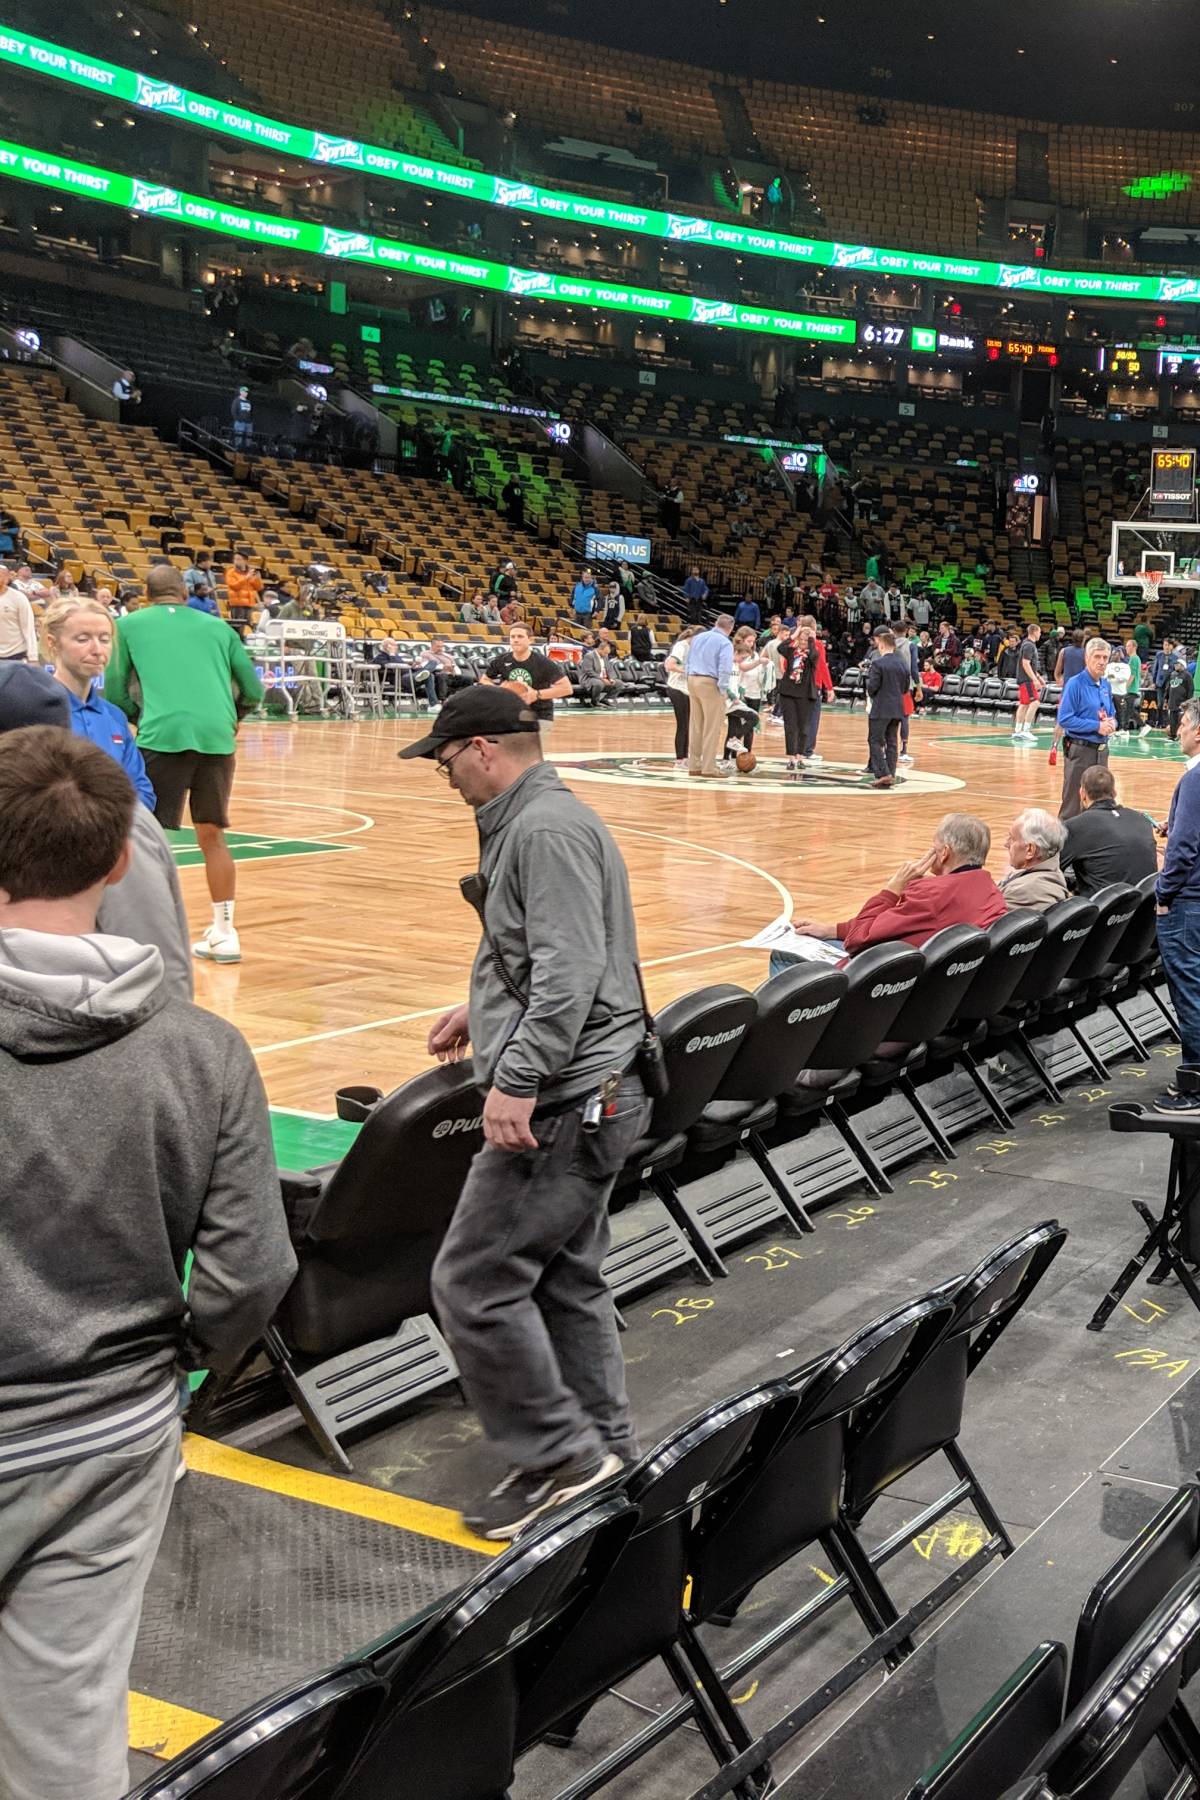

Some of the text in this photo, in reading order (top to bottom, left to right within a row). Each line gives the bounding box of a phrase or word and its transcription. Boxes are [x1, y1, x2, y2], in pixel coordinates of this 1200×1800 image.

[30, 44, 116, 86] YOUR THIRST
[139, 84, 182, 106] Sprite
[189, 101, 291, 145] OBEY YOUR THIRST
[316, 140, 361, 163] Sprite
[22, 156, 110, 192] YOUR THIRST
[366, 154, 476, 190] OBEY YOUR THIRST
[135, 188, 178, 211] Sprite
[497, 183, 534, 204] Sprite
[185, 202, 300, 241] OBEY YOUR THIRST
[540, 197, 648, 226] OBEY YOUR THIRST
[669, 217, 709, 239] Sprite
[326, 234, 372, 257] Sprite
[715, 230, 814, 257] OBEY YOUR THIRST
[378, 246, 489, 279] OBEY YOUR THIRST
[835, 247, 874, 267] Sprite
[881, 256, 980, 277] OBEY YOUR THIRST
[509, 272, 552, 295] Sprite
[1002, 269, 1037, 287] Sprite
[1044, 276, 1141, 292] OBEY YOUR THIRST
[559, 283, 672, 310] OBEY YOUR THIRST
[1163, 280, 1197, 300] Sprite
[694, 303, 733, 322] Sprite
[740, 313, 844, 336] OBEY YOUR THIRST
[863, 325, 904, 346] 6:27
[940, 335, 974, 349] Bank
[1008, 342, 1033, 354] 65:40
[792, 452, 808, 467] 10
[1157, 454, 1190, 468] 65:40
[1023, 475, 1039, 488] 10
[1071, 924, 1093, 941] Putnam
[1018, 937, 1043, 955] Putnam
[956, 956, 985, 974] Putnam
[881, 976, 918, 997] Putnam
[800, 998, 840, 1020] Putnam
[698, 1023, 746, 1051] Putnam
[976, 1139, 1018, 1155] 24
[908, 1171, 958, 1189] 25
[827, 1206, 875, 1225] 26
[745, 1246, 803, 1271] 27
[652, 1297, 715, 1325] 28
[1114, 1347, 1190, 1378] 13A
